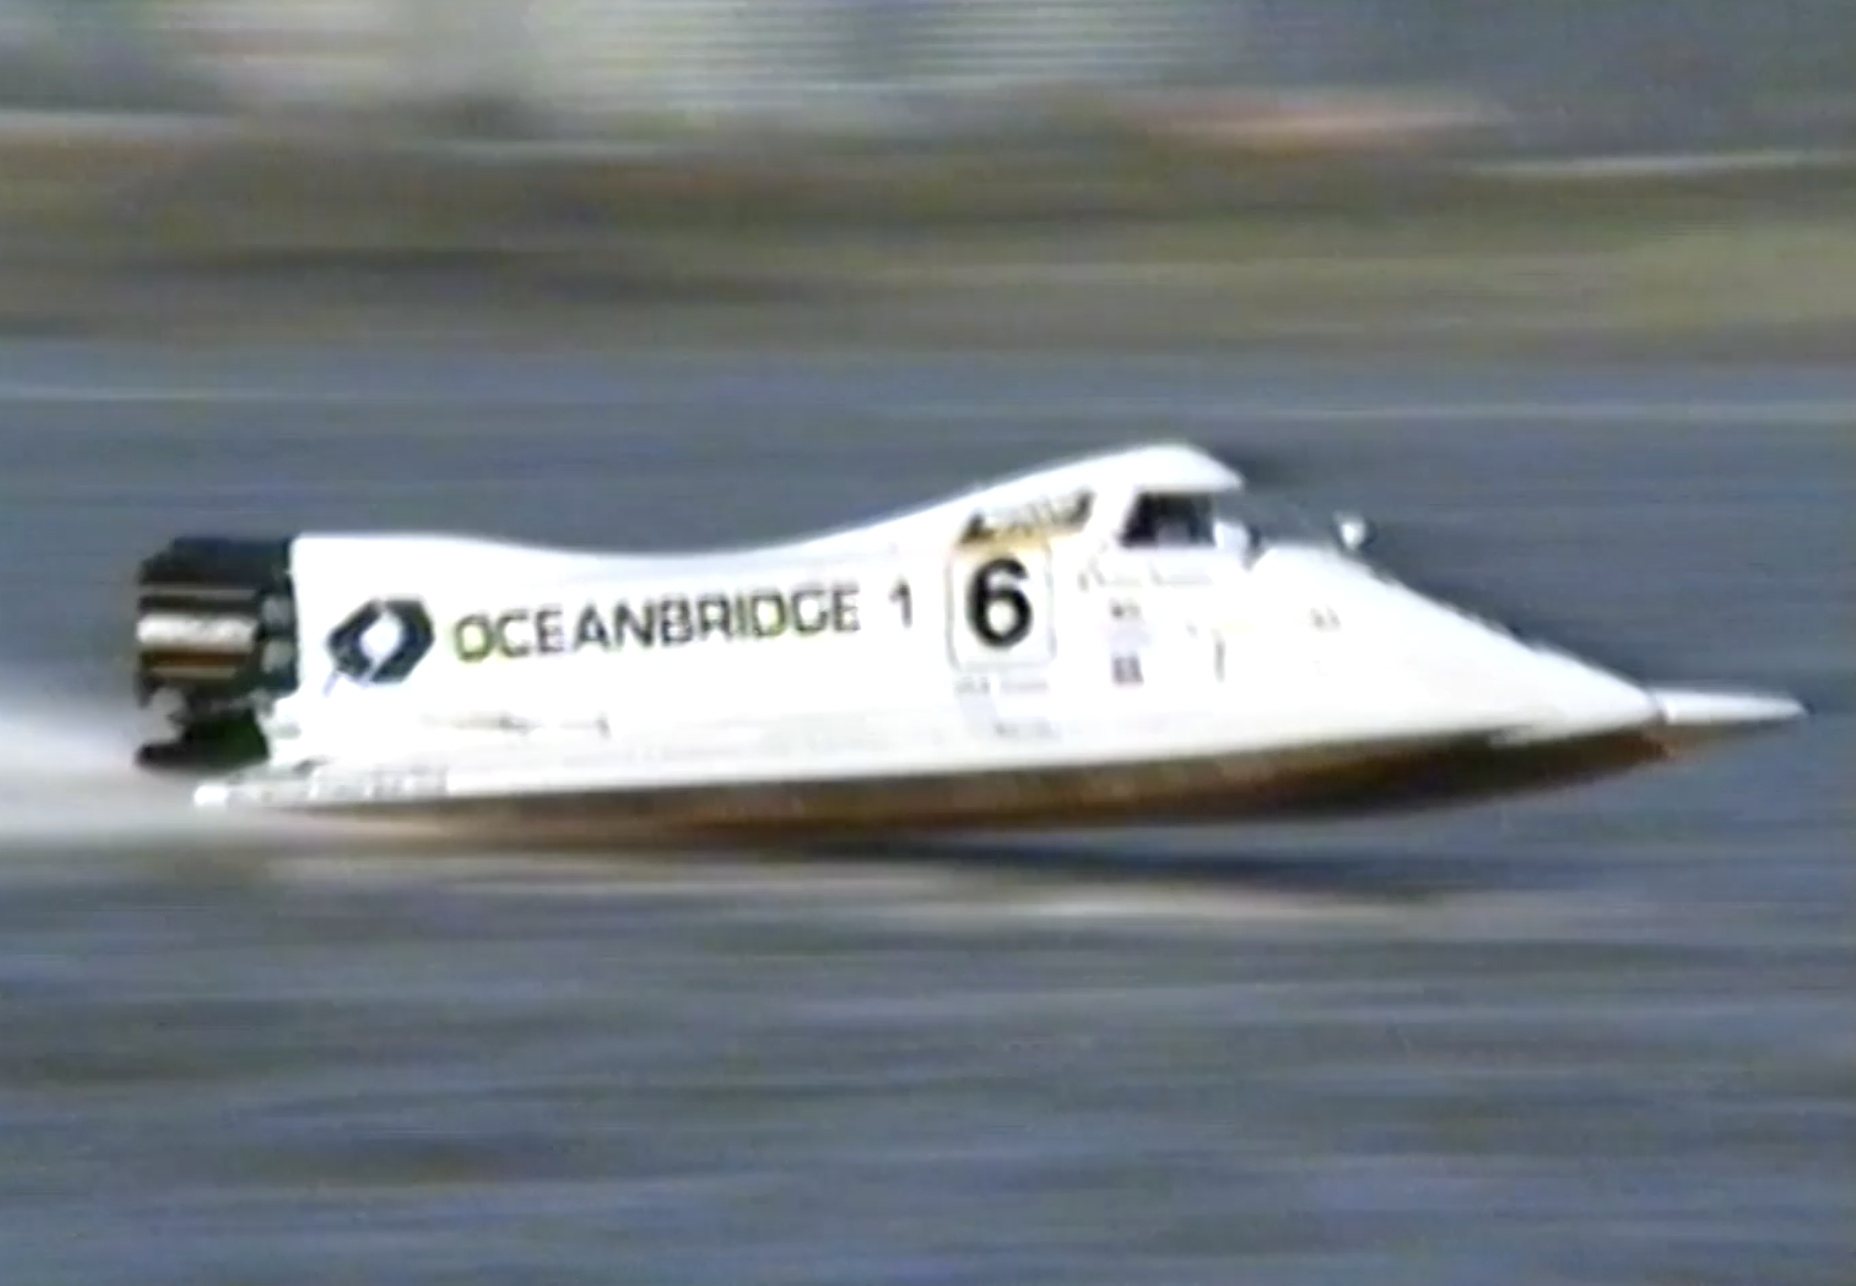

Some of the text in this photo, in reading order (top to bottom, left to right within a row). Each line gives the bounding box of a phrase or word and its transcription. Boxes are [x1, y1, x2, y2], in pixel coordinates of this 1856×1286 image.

[453, 577, 914, 662] OCEANBRIDGE 1
[966, 556, 1033, 650] 6
